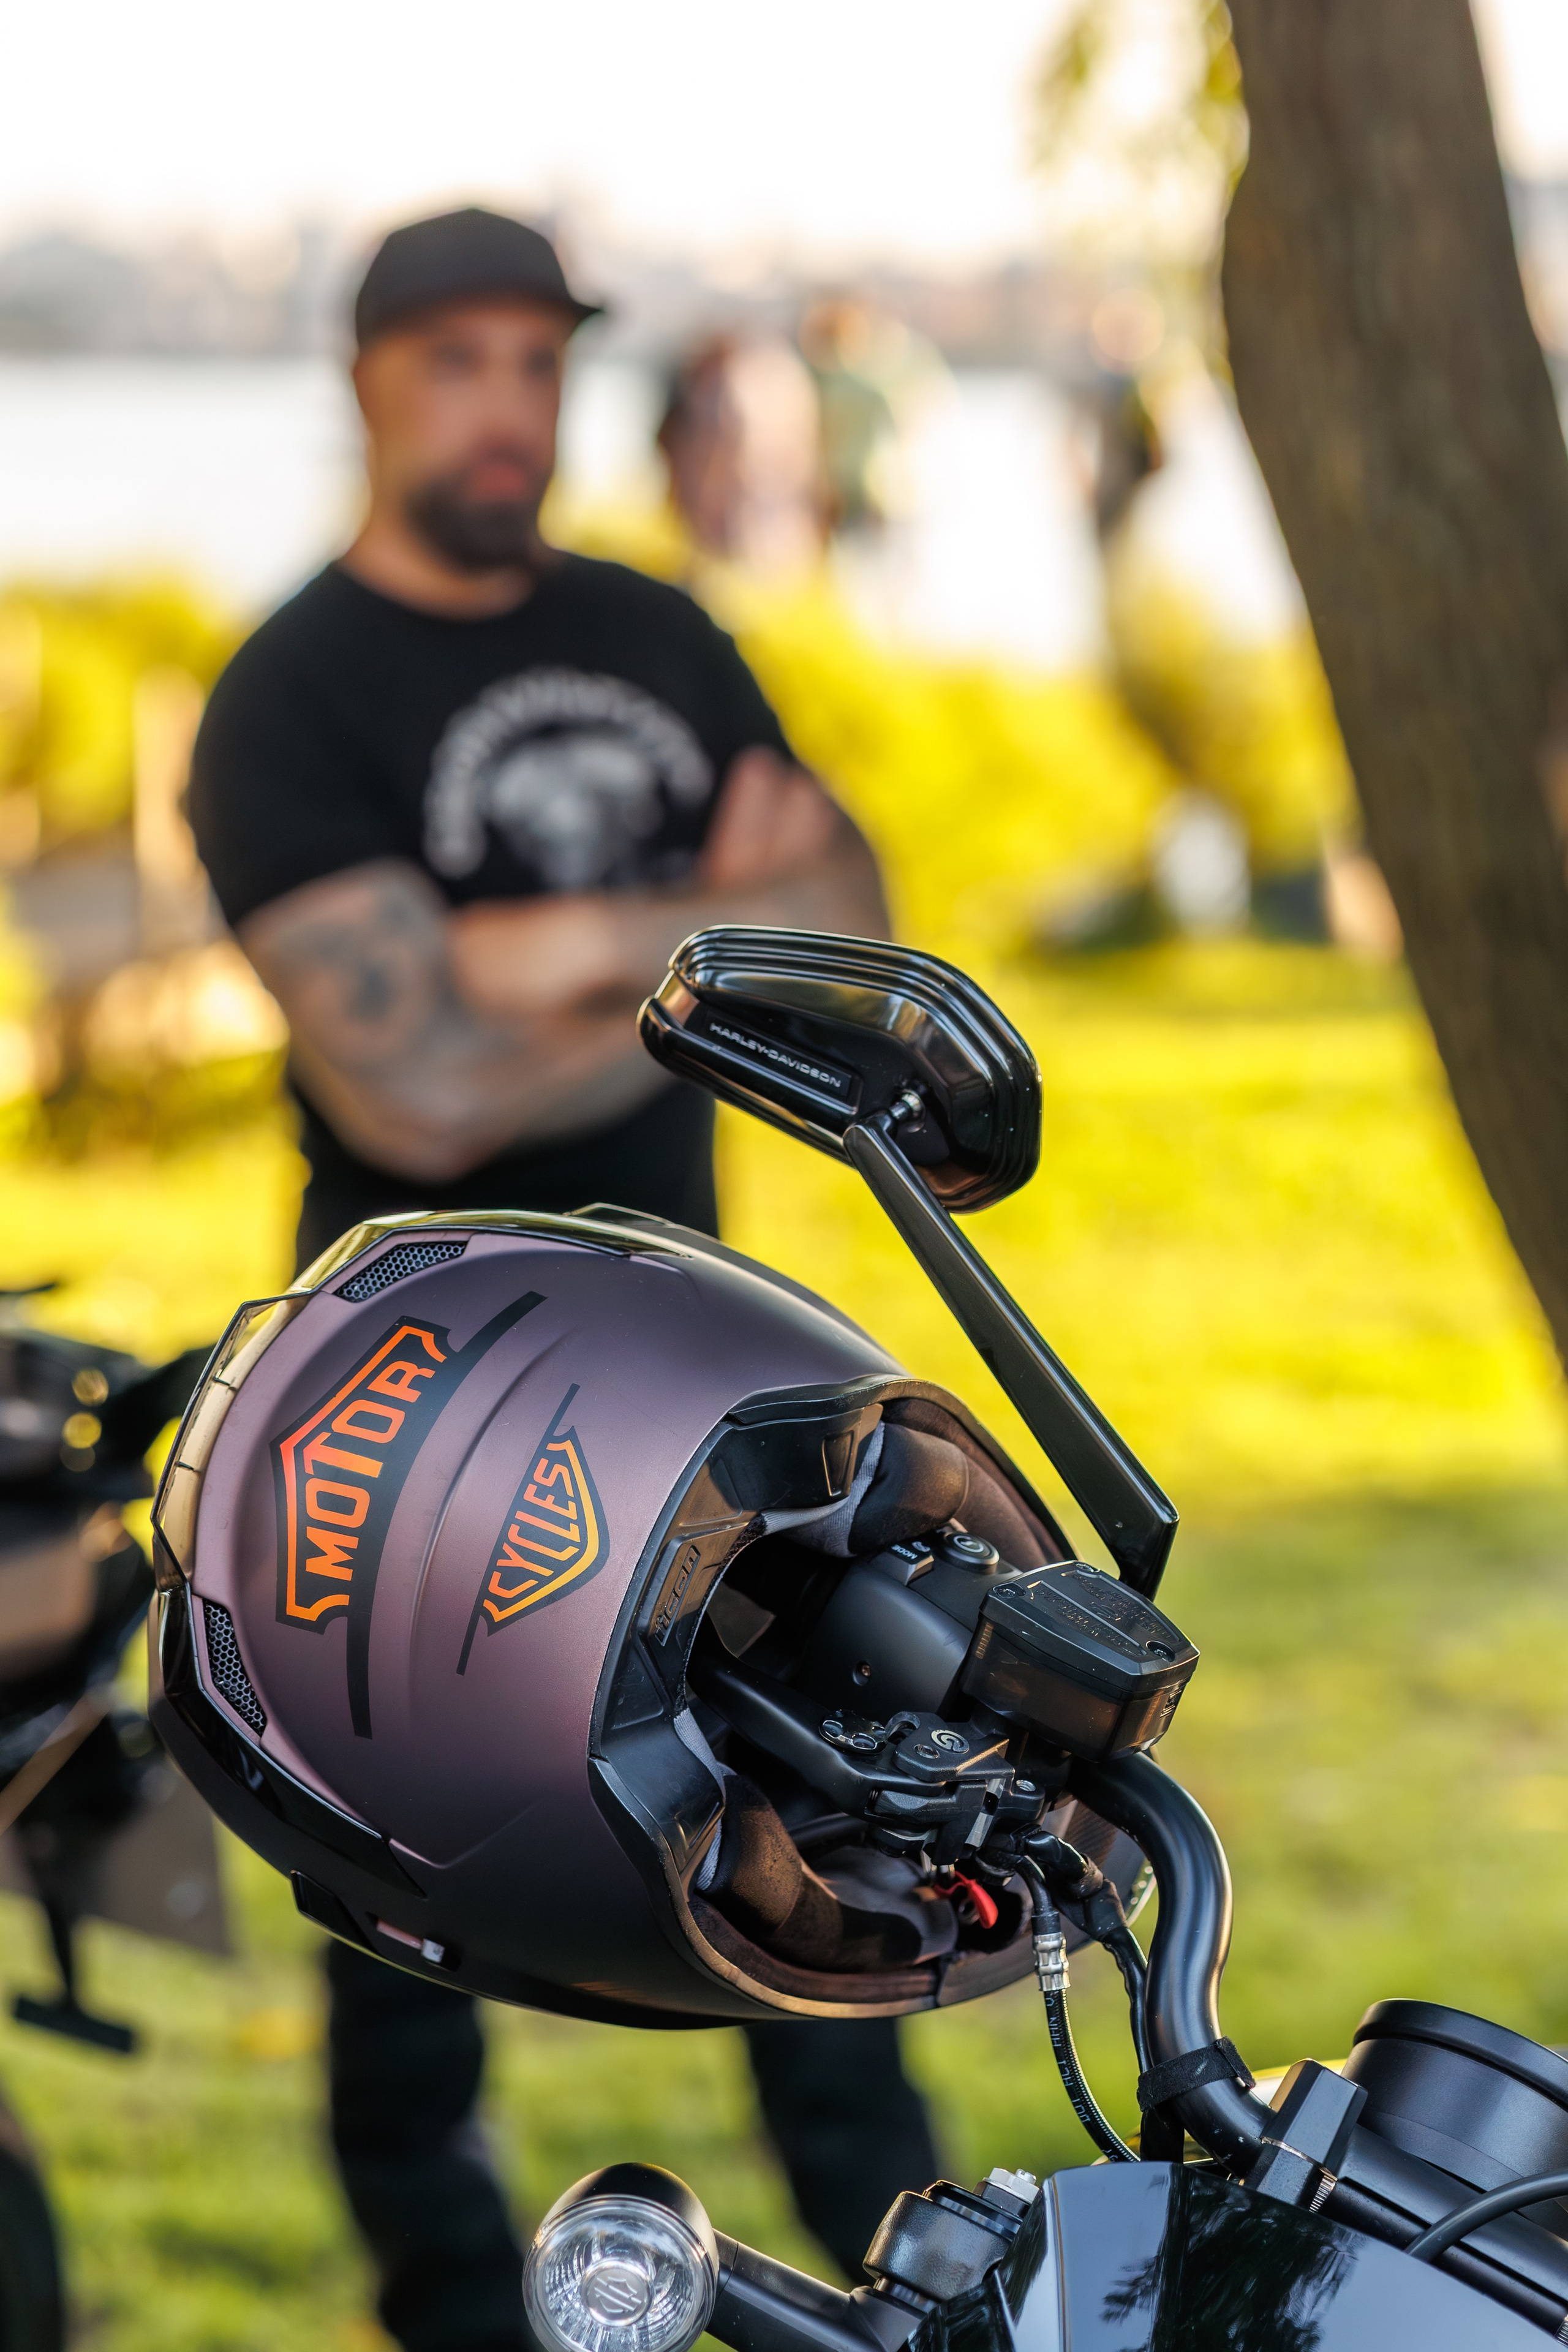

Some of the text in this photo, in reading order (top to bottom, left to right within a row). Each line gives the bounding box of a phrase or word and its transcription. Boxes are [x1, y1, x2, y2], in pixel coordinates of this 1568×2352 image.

[709, 1022, 842, 1088] HARLEY-DAVIDSON
[303, 1360, 435, 1583] MOTOR
[488, 1457, 580, 1599] CYCLES
[891, 1544, 918, 1559] MODE
